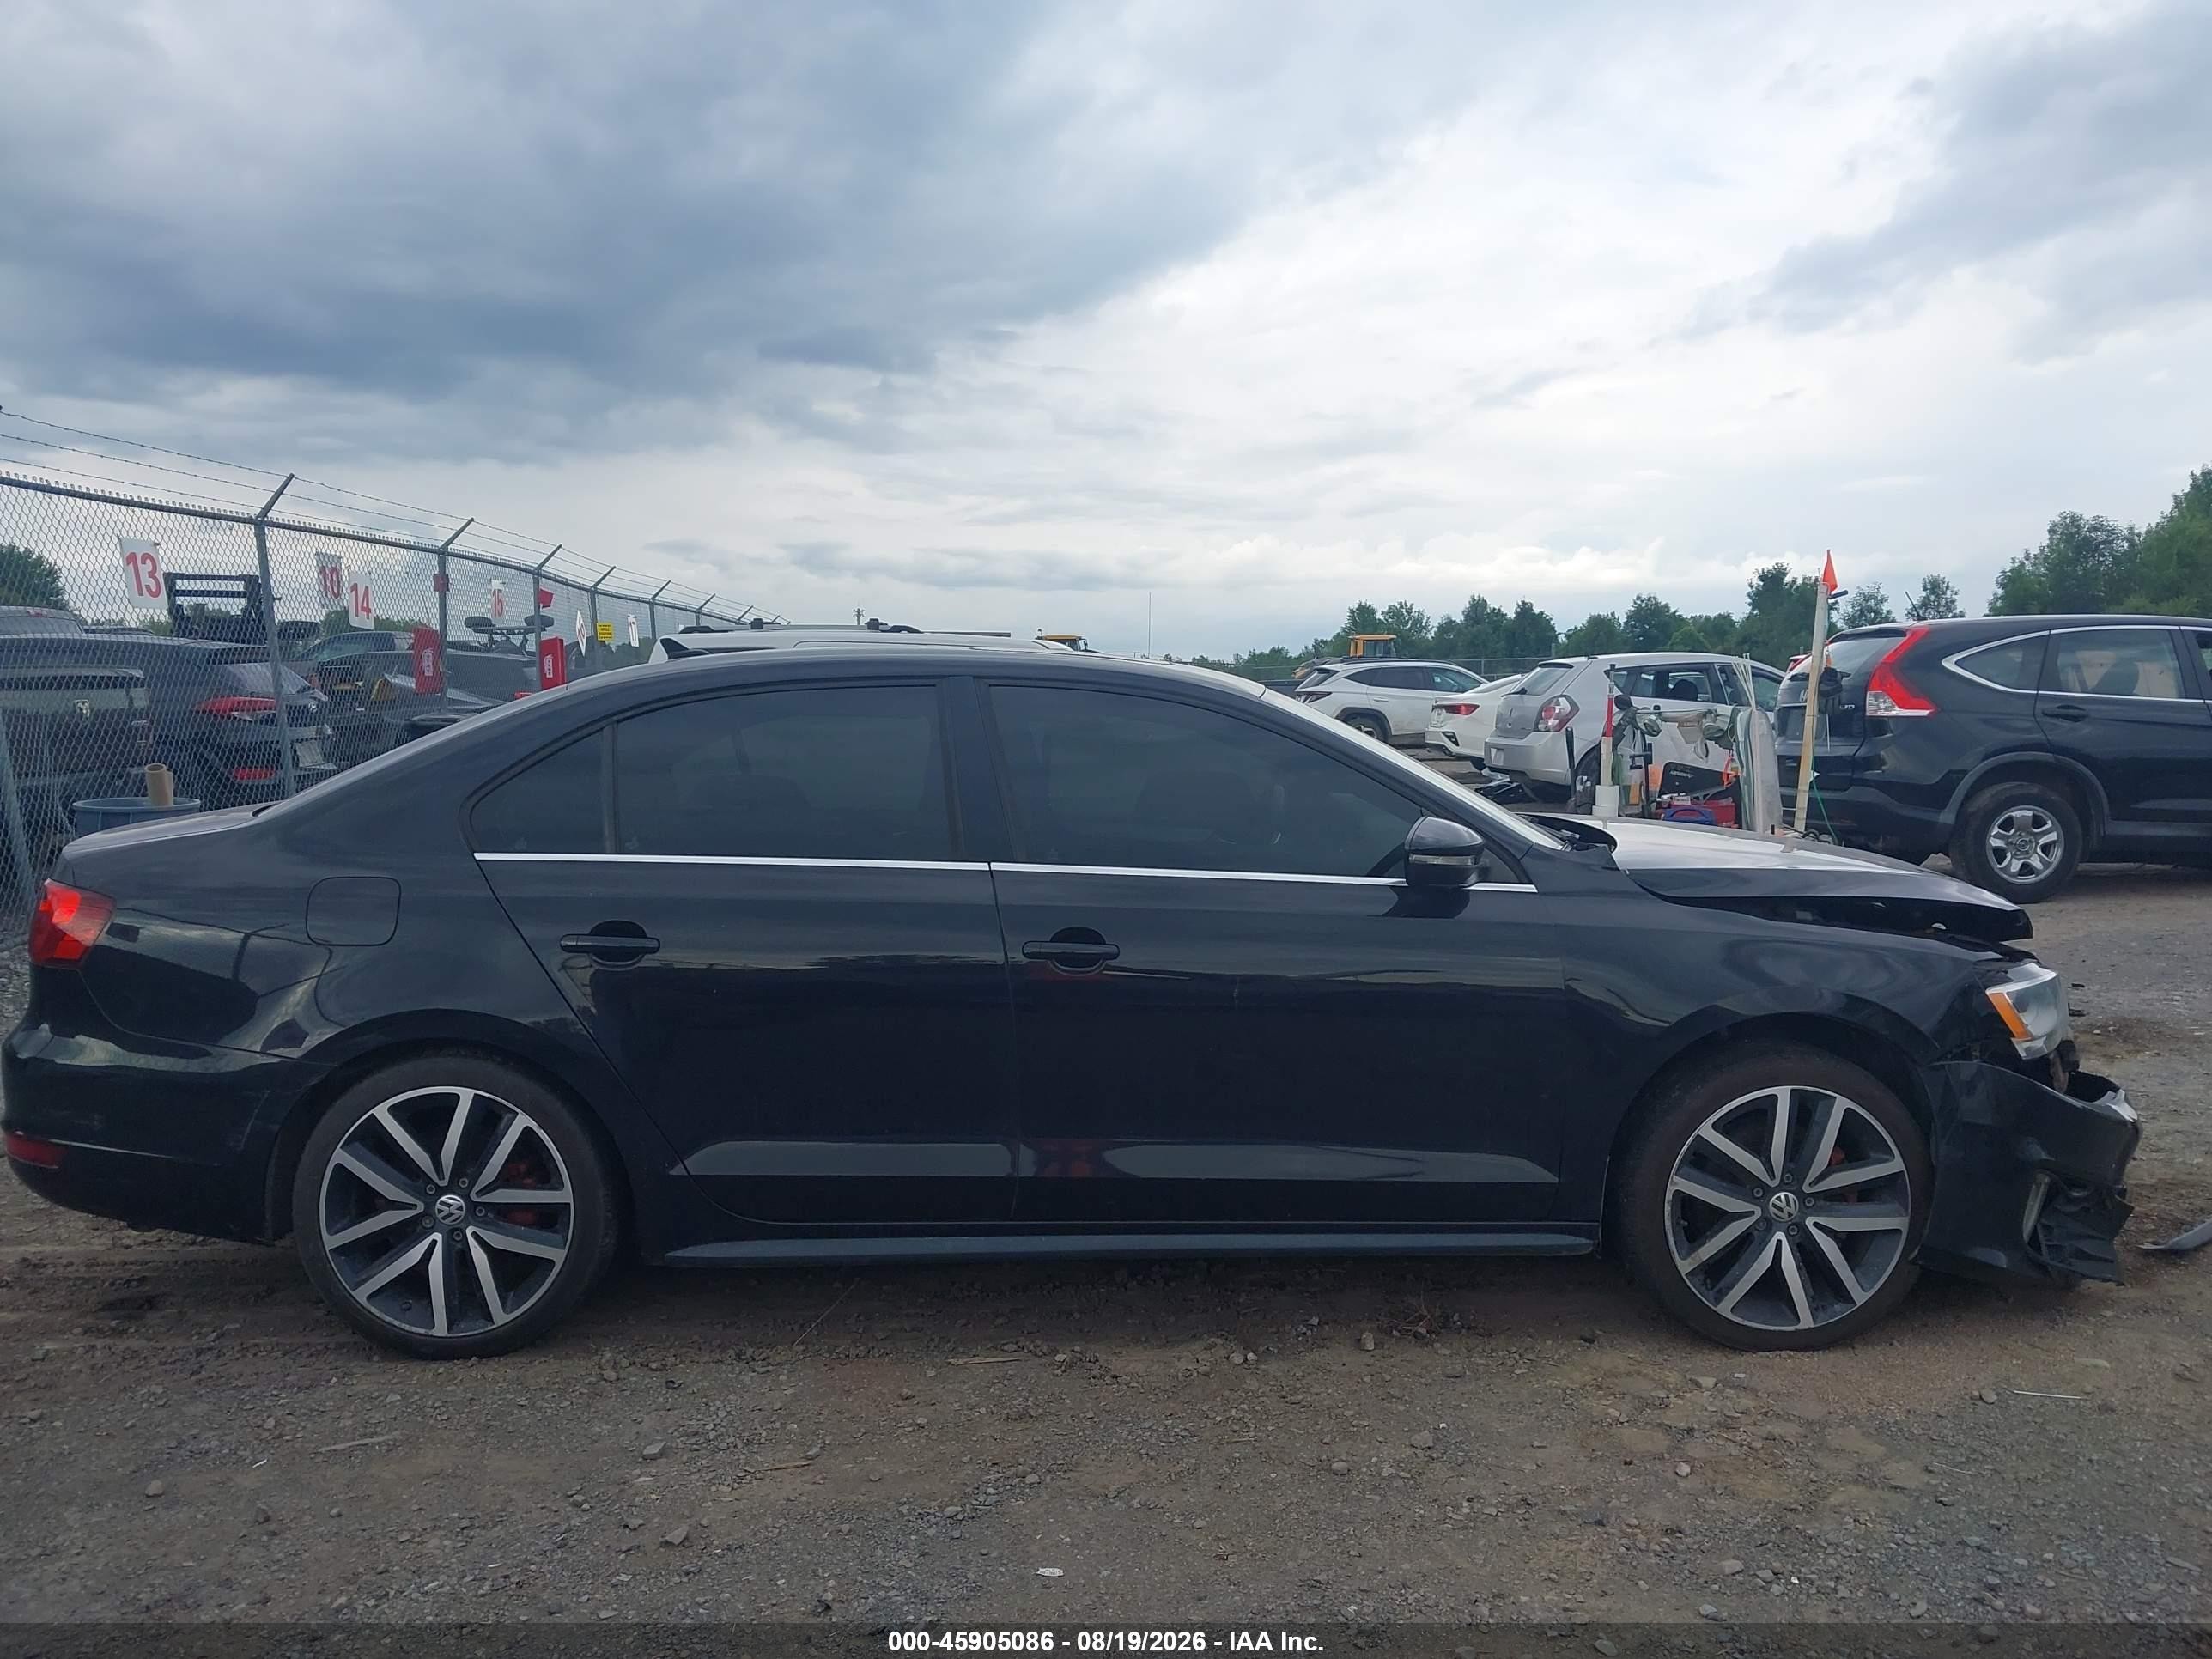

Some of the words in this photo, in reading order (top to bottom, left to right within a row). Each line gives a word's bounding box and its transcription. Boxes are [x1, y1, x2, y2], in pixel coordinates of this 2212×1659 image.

[125, 551, 161, 599] 13
[319, 565, 341, 599] 10
[349, 582, 372, 620] 14
[492, 589, 504, 617] 15
[629, 621, 637, 643] 17
[435, 1194, 465, 1224] VW
[1770, 1192, 1799, 1221] VW
